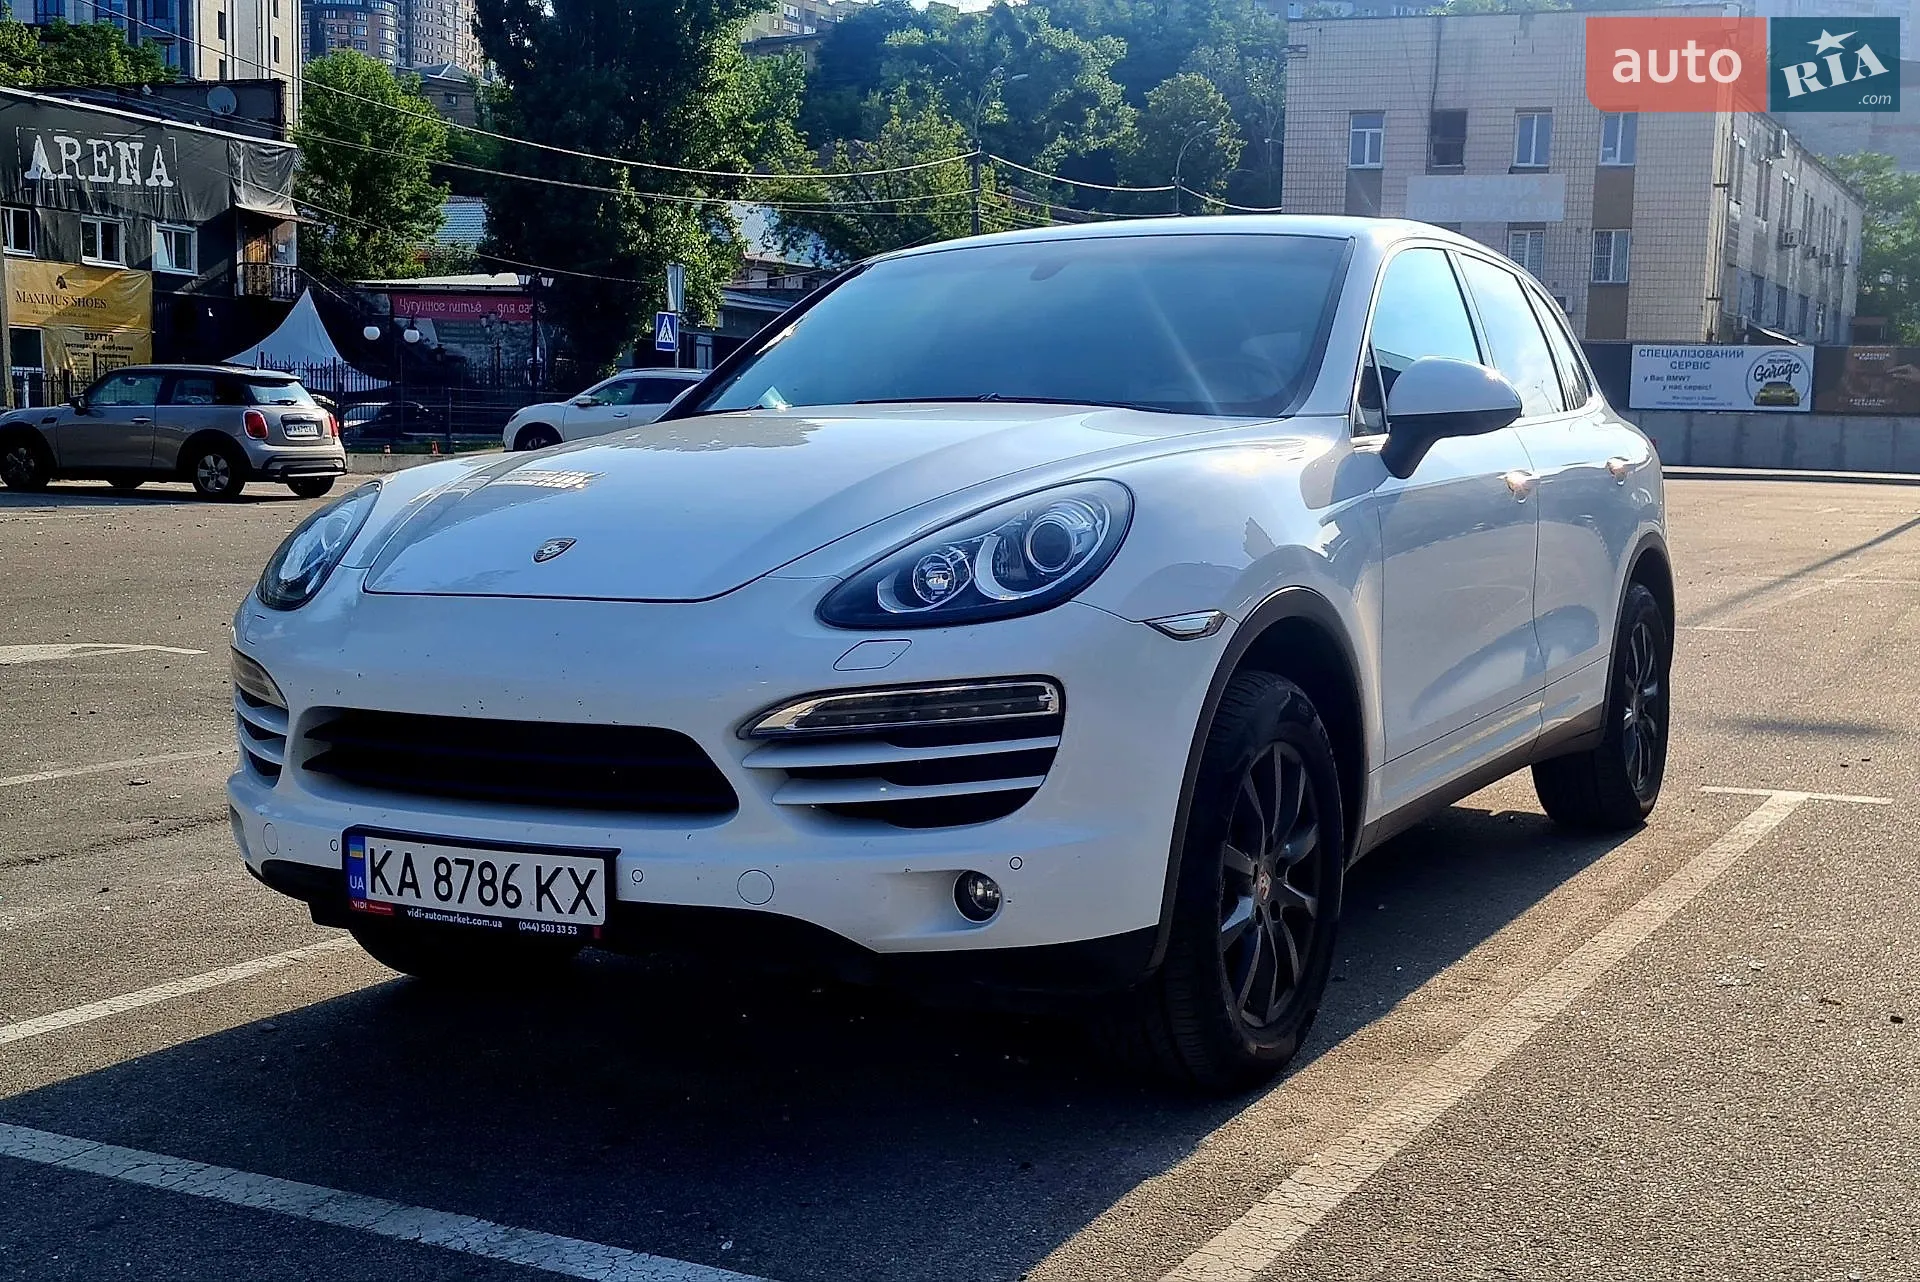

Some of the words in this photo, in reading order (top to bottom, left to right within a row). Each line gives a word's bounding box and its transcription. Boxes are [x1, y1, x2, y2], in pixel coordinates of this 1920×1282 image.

[24, 134, 174, 188] ARENA
[16, 290, 69, 306] MAXIMUS
[71, 296, 107, 309] SHOES
[497, 303, 515, 318] для
[84, 332, 114, 342] ВЗУТТЯ
[1670, 360, 1711, 370] СЕРВІС
[1753, 362, 1802, 383] Garage
[350, 875, 365, 890] UA
[369, 847, 422, 899] KA
[433, 856, 523, 909] 8786
[535, 865, 598, 917] KX
[407, 909, 503, 928] vidi-automarket.com.ua
[518, 921, 540, 932] (044)
[541, 923, 556, 933] 503
[556, 925, 567, 934] 33
[567, 926, 578, 935] 53
